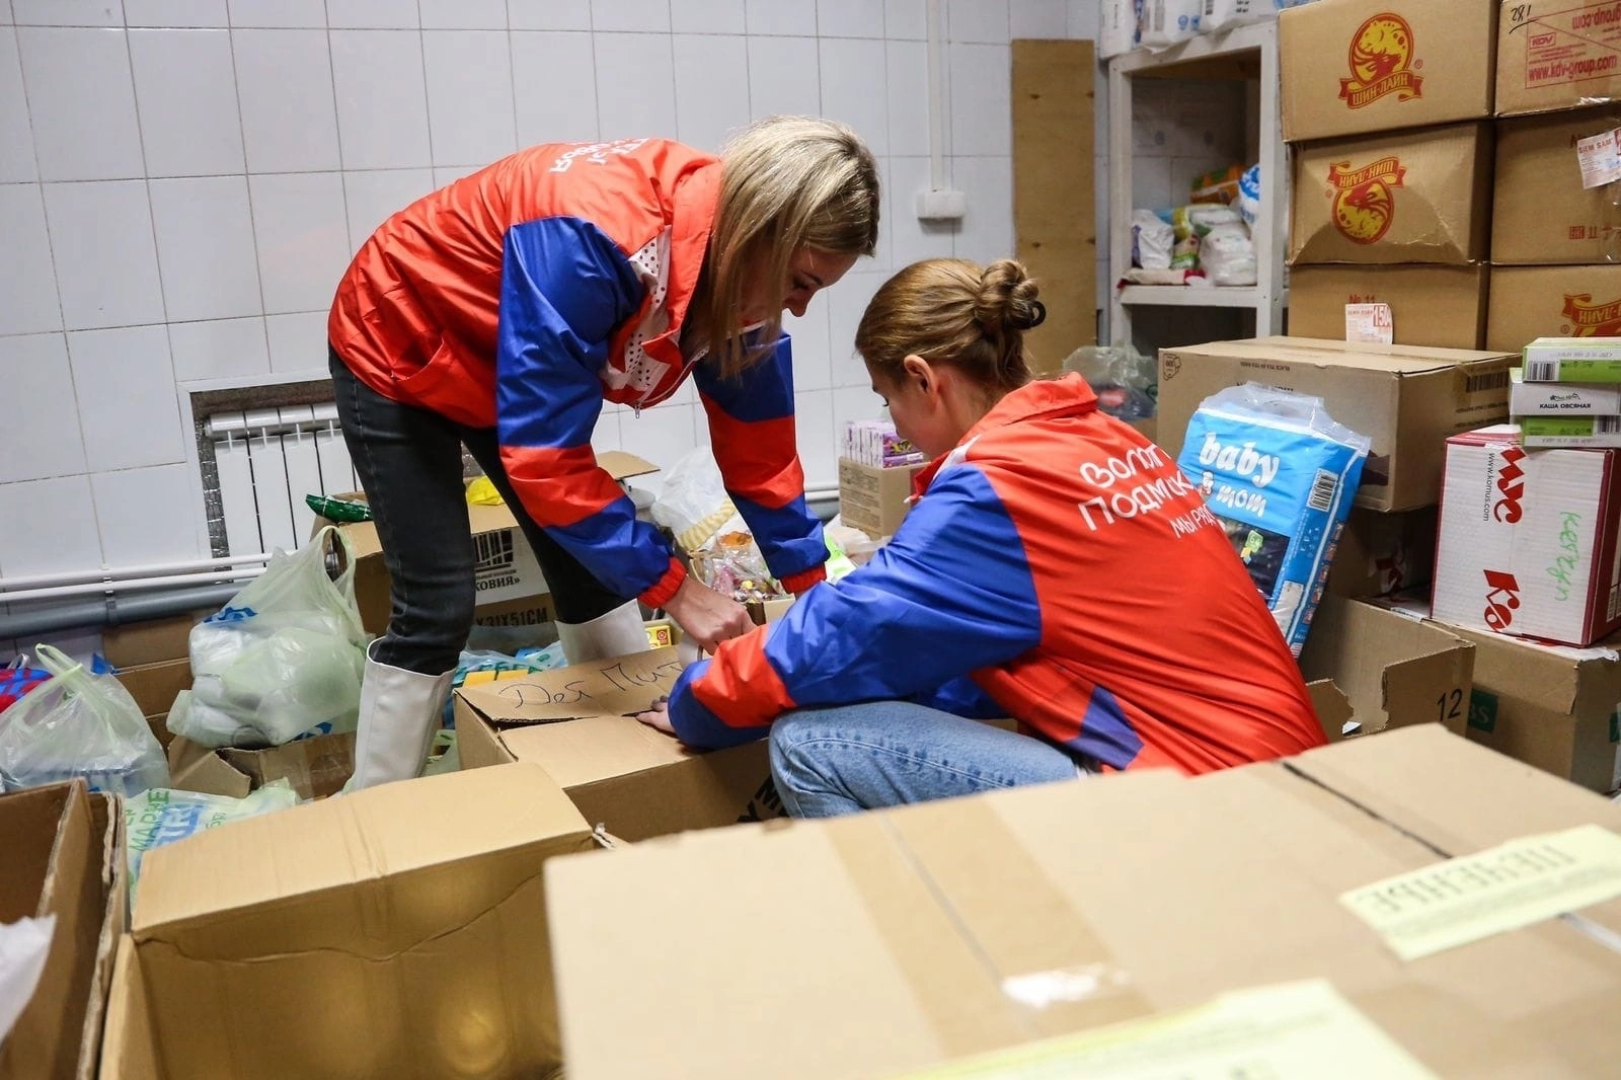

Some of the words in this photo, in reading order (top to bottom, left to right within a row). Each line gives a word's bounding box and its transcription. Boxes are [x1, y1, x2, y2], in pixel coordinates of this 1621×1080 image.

[1528, 55, 1617, 81] www.kdv-group.com
[1199, 432, 1280, 487] baby
[1216, 485, 1267, 517] mom
[1483, 453, 1495, 522] www.komus.com
[1437, 688, 1463, 722] 12
